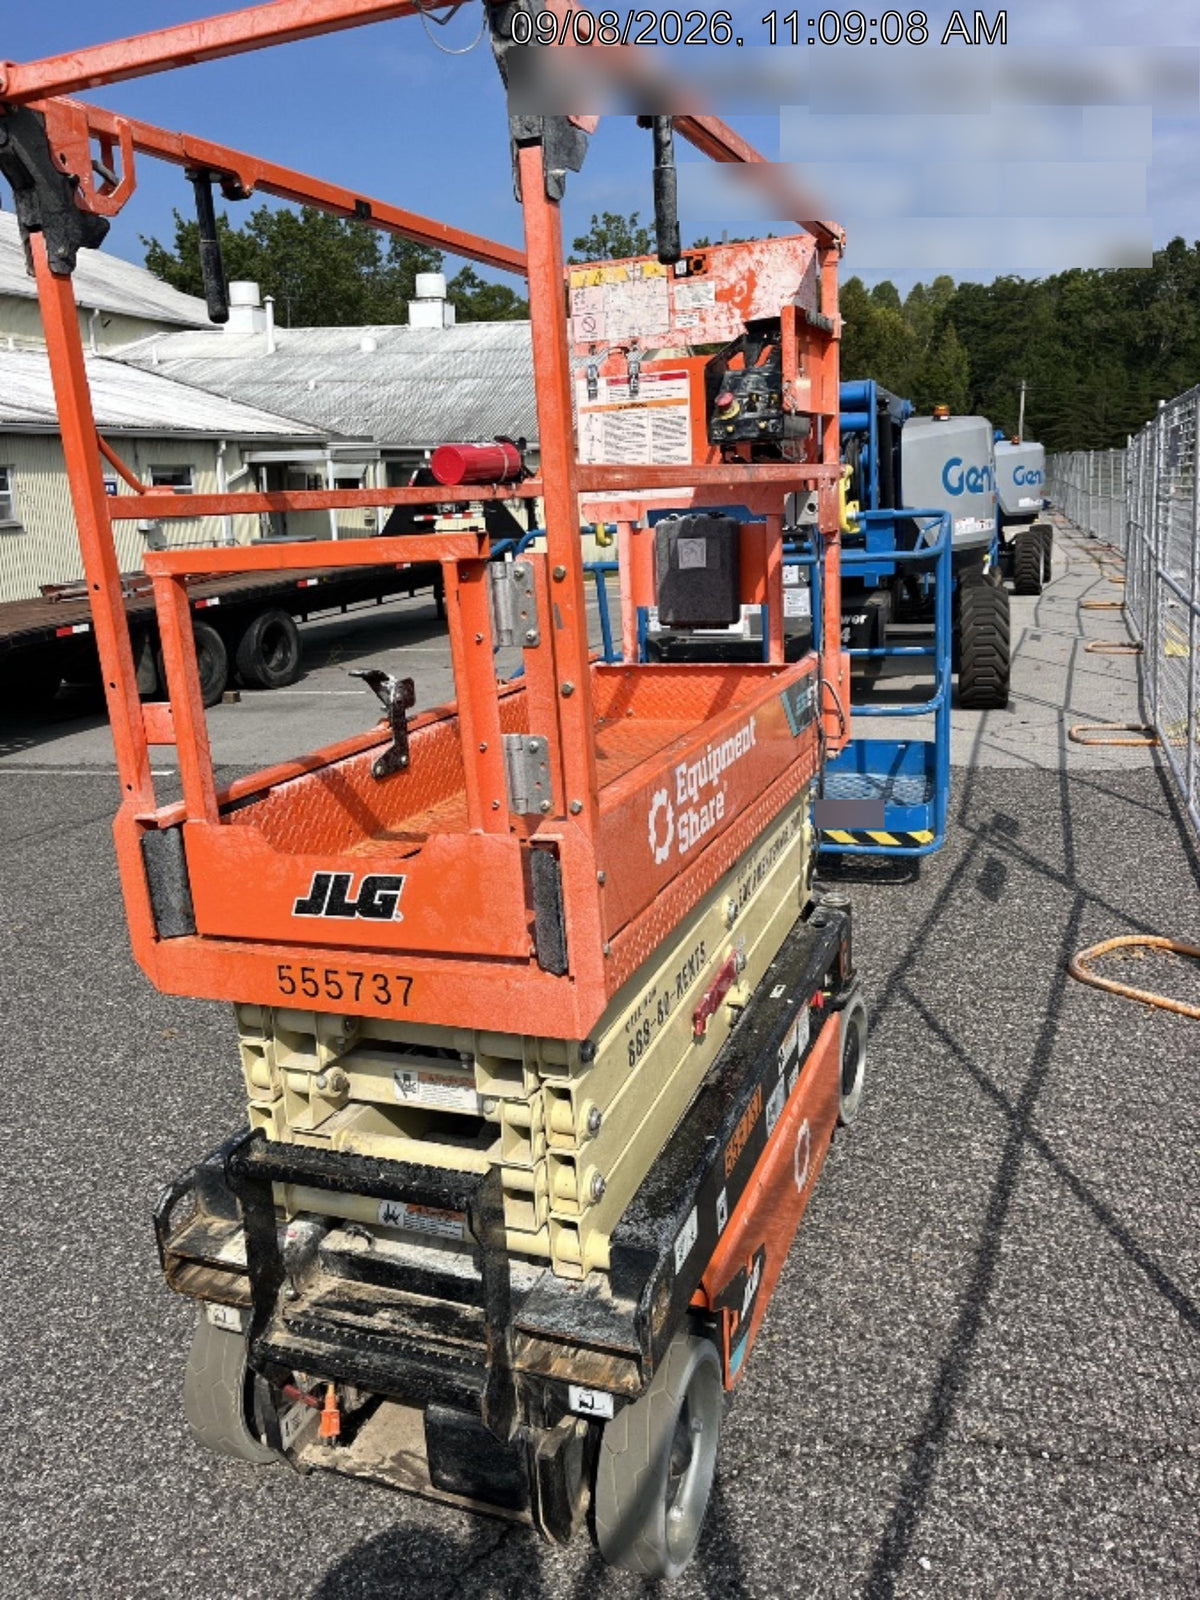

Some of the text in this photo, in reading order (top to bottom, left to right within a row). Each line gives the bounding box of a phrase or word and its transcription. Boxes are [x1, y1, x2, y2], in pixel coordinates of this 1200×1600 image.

[675, 715, 756, 806] Equipment
[678, 791, 725, 854] Share
[292, 871, 406, 922] JLG
[277, 964, 414, 1006] 555737
